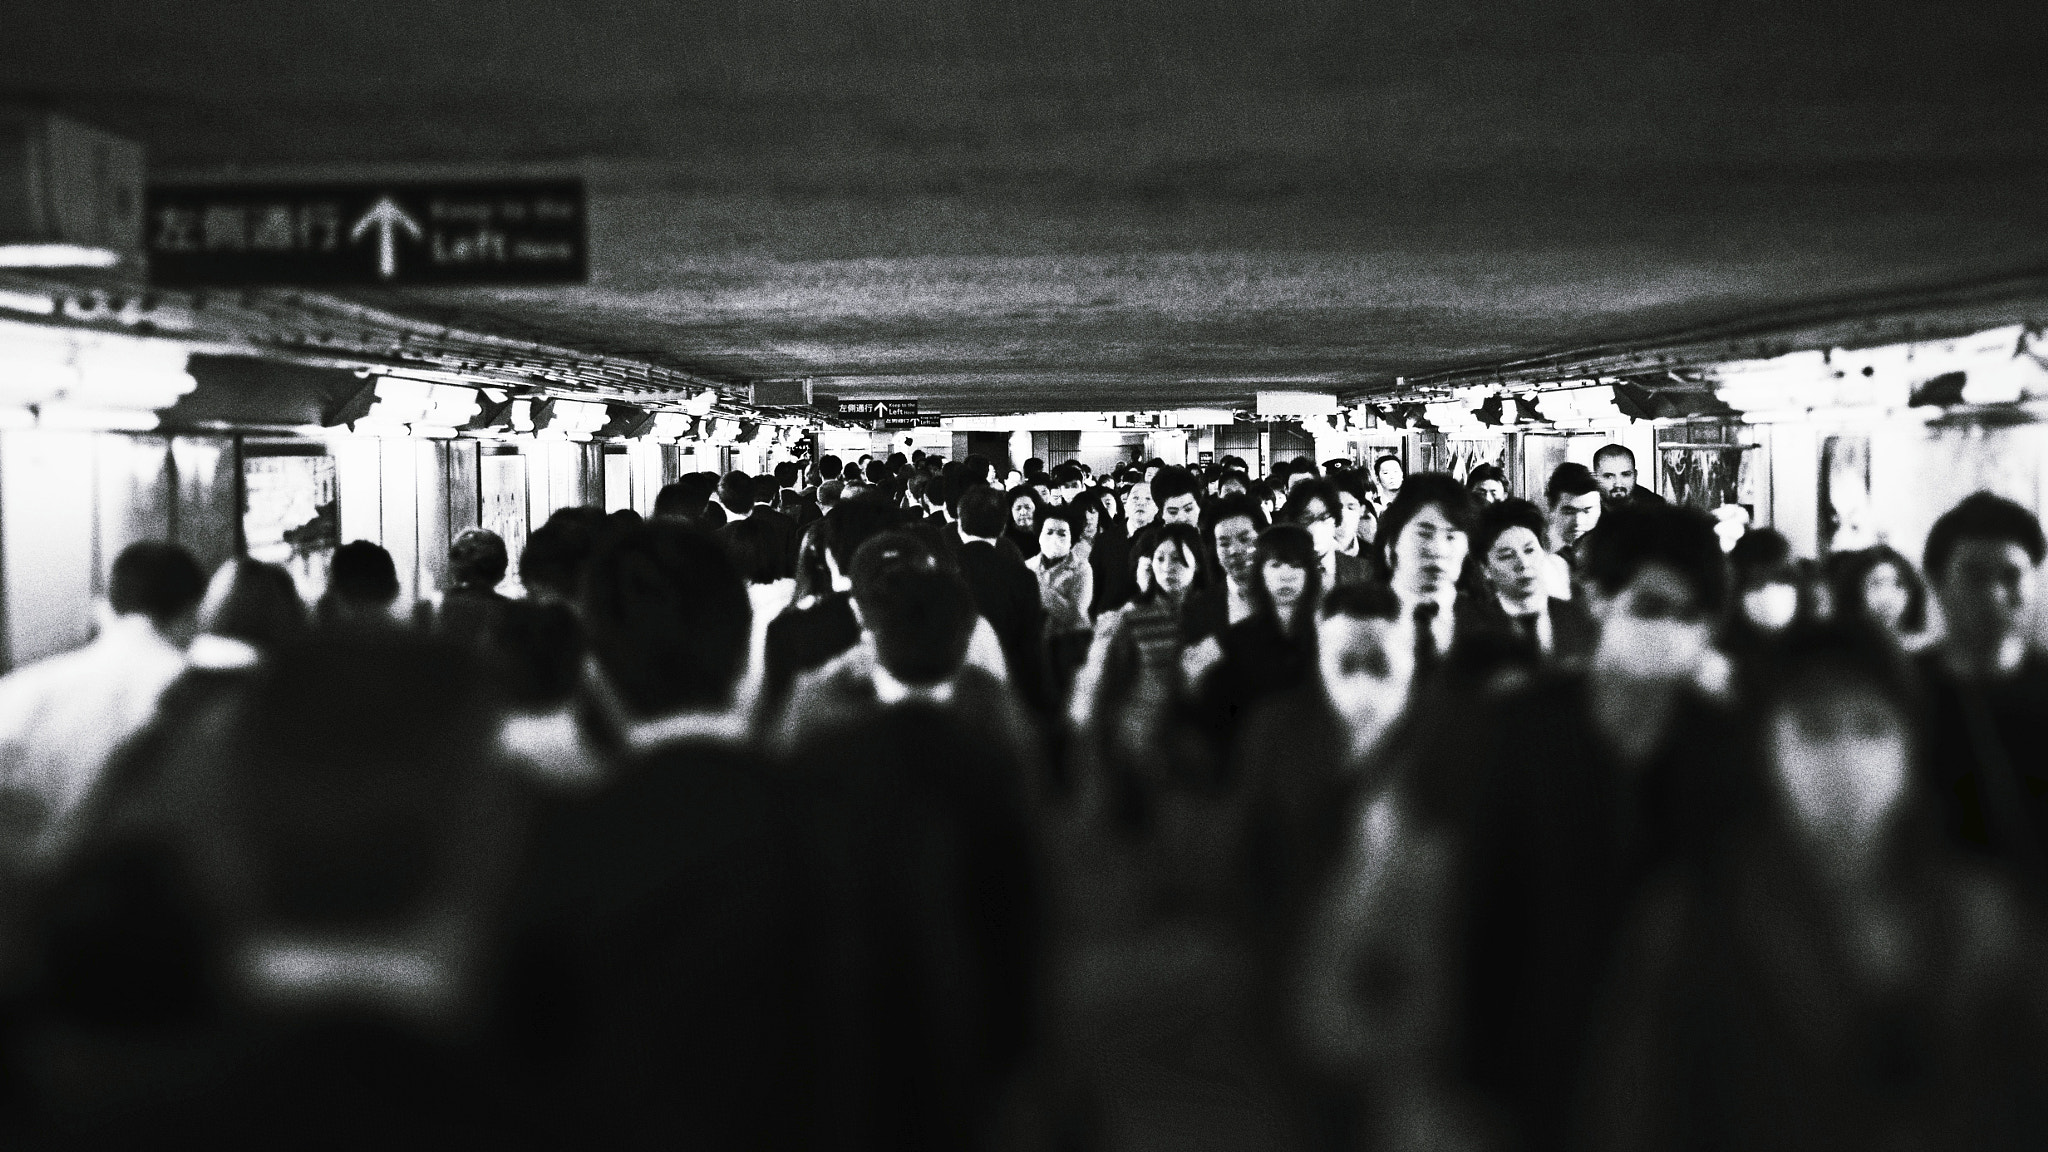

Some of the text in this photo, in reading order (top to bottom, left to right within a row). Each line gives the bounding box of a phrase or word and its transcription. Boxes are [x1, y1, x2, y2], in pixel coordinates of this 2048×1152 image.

[432, 230, 505, 263] Left
[839, 404, 873, 413] 左側通行
